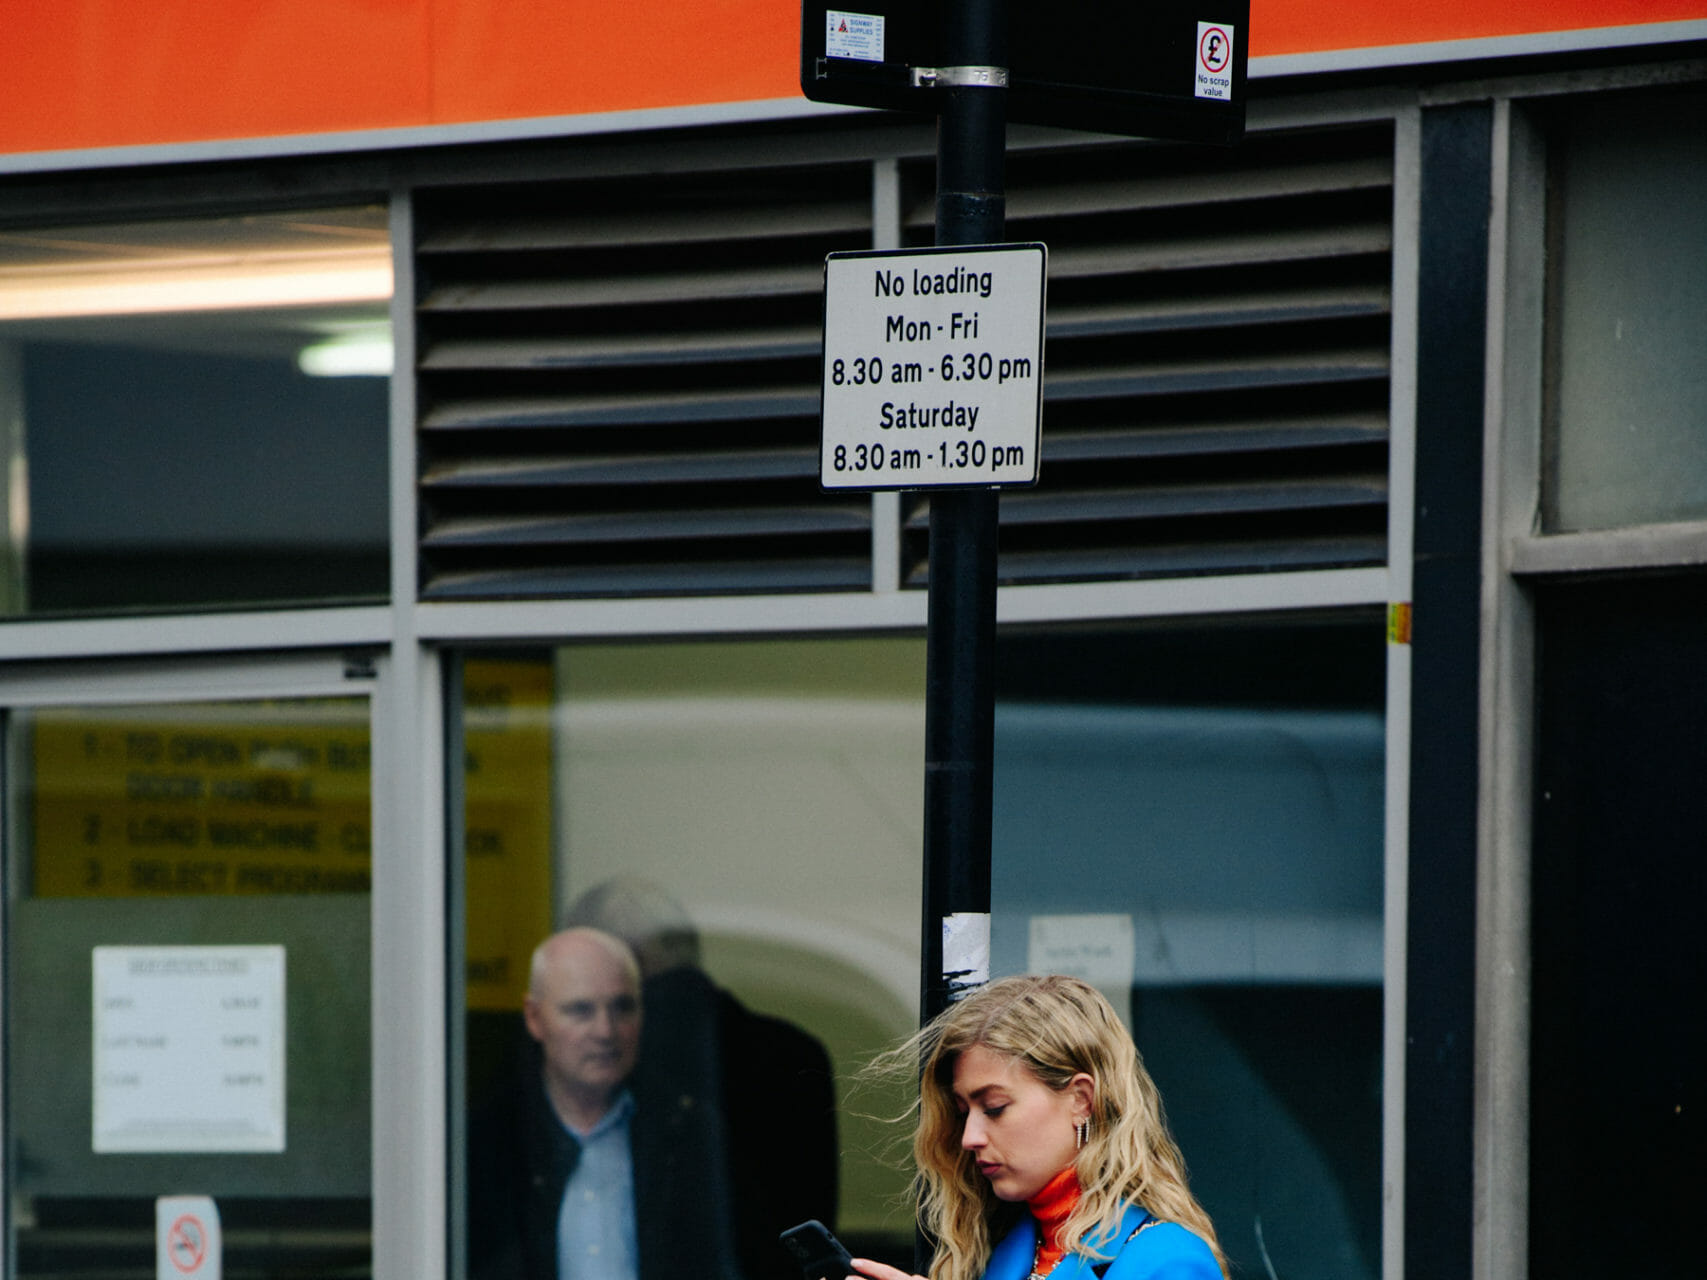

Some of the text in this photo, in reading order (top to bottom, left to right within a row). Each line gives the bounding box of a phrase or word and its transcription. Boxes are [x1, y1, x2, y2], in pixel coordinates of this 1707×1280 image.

[1198, 74, 1230, 88] No scrap
[1203, 87, 1223, 97] value
[874, 266, 993, 299] No loading
[885, 314, 932, 343] Mon
[950, 311, 979, 340] Fri
[831, 356, 883, 386] 8.30
[890, 362, 923, 384] am
[940, 351, 993, 382] 6.30
[998, 357, 1032, 385] pm
[879, 399, 980, 433] Saturday
[833, 442, 885, 472] 8.30
[889, 449, 921, 470] am
[939, 439, 987, 469] 1.30
[991, 444, 1024, 473] pm
